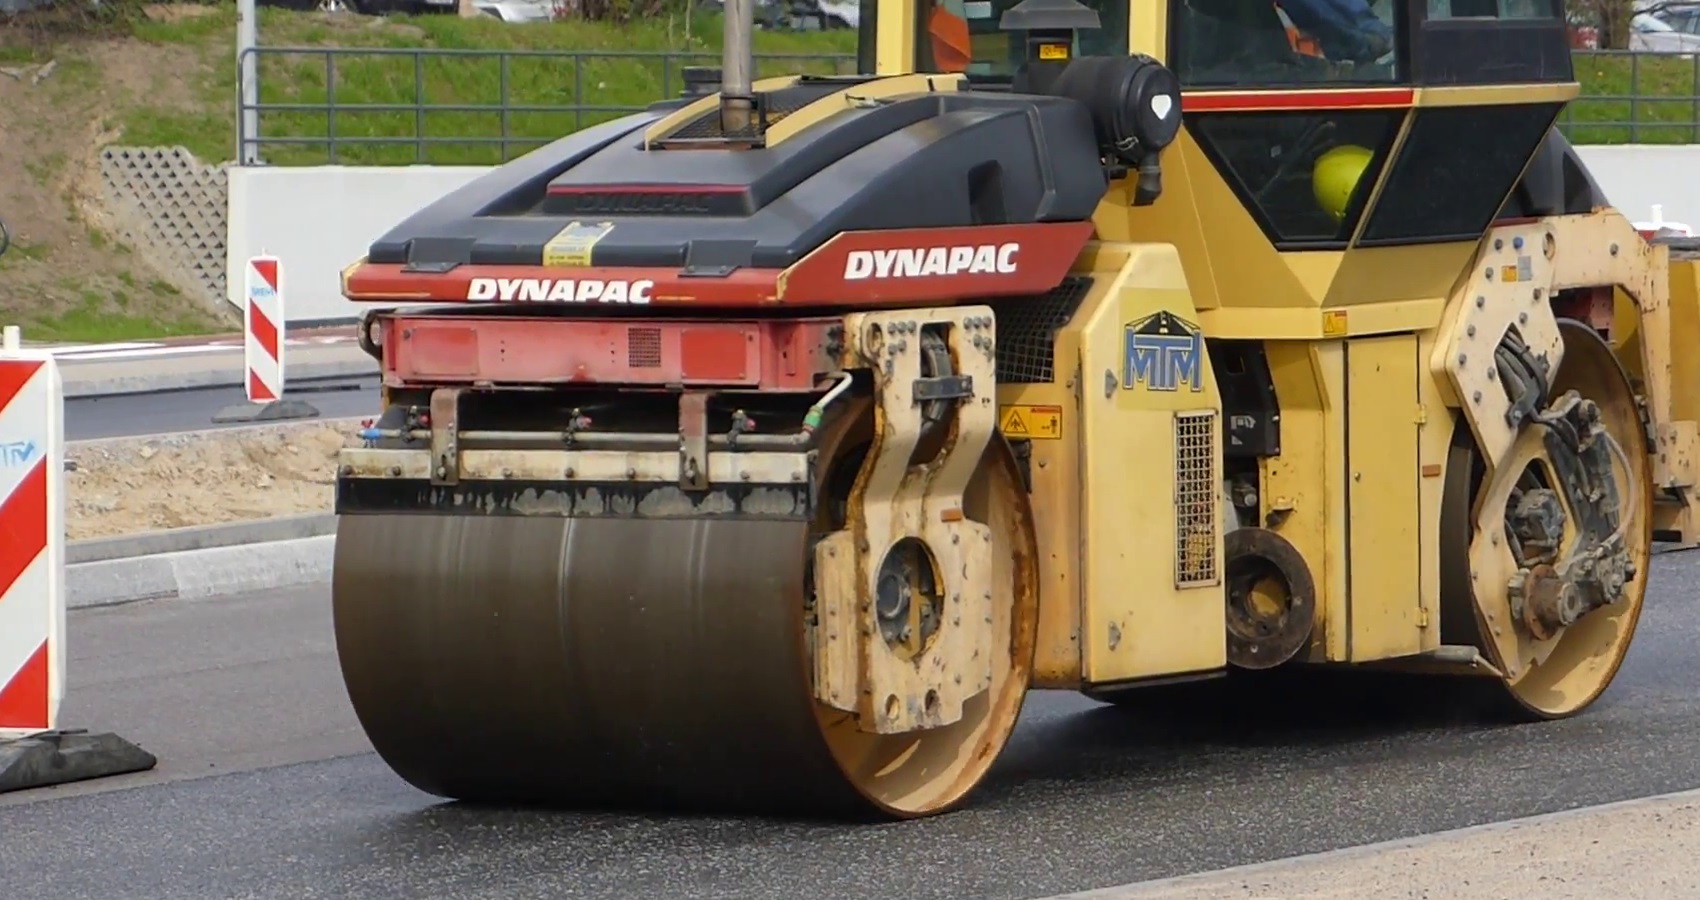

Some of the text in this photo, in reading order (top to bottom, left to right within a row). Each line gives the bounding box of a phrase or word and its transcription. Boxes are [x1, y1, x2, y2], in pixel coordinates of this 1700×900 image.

[843, 243, 1020, 280] DYNAPAC
[467, 278, 654, 304] DYNAPAC
[1122, 325, 1202, 392] MTM
